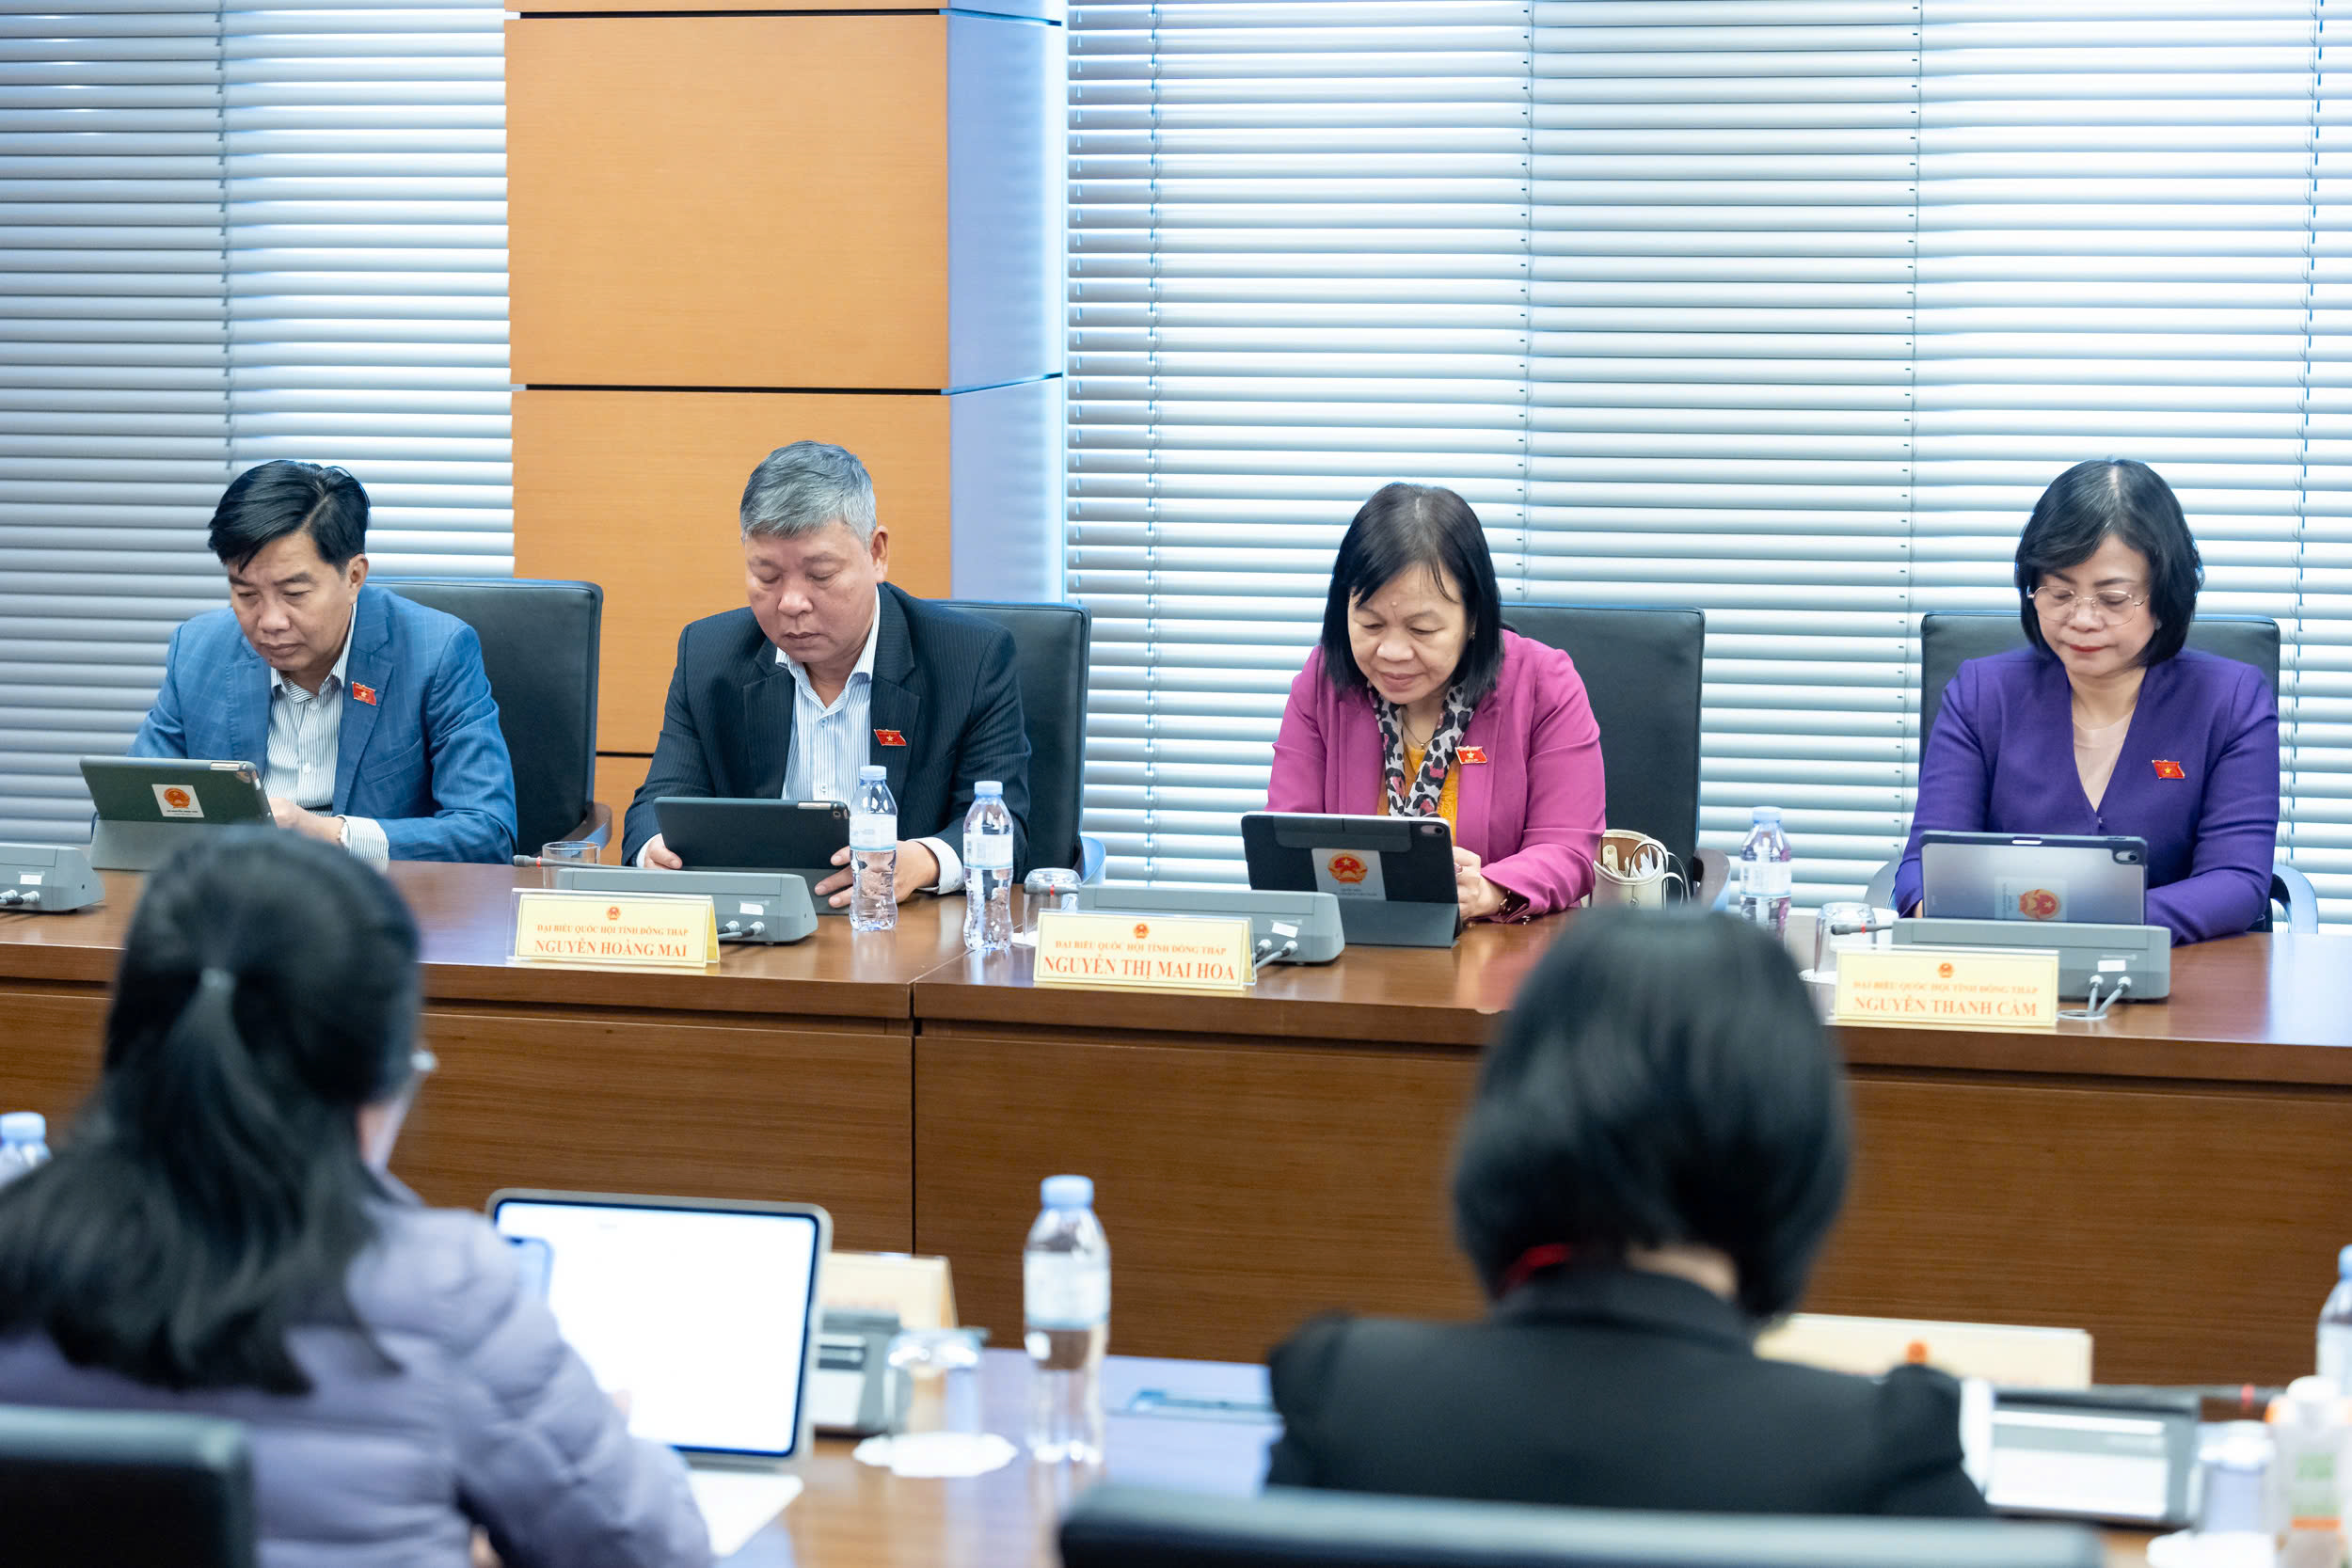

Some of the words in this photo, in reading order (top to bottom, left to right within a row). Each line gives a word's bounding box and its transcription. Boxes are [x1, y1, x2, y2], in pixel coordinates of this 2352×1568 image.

[534, 937, 596, 954] NGUYỄN
[600, 939, 655, 957] HOÀNG
[658, 943, 688, 958] MAI
[1043, 953, 1116, 974] NGUYỄN
[1121, 959, 1152, 979] THỊ
[1157, 961, 1191, 978] MAI
[1197, 963, 1235, 981] HOA
[1931, 1000, 1993, 1016] THANH
